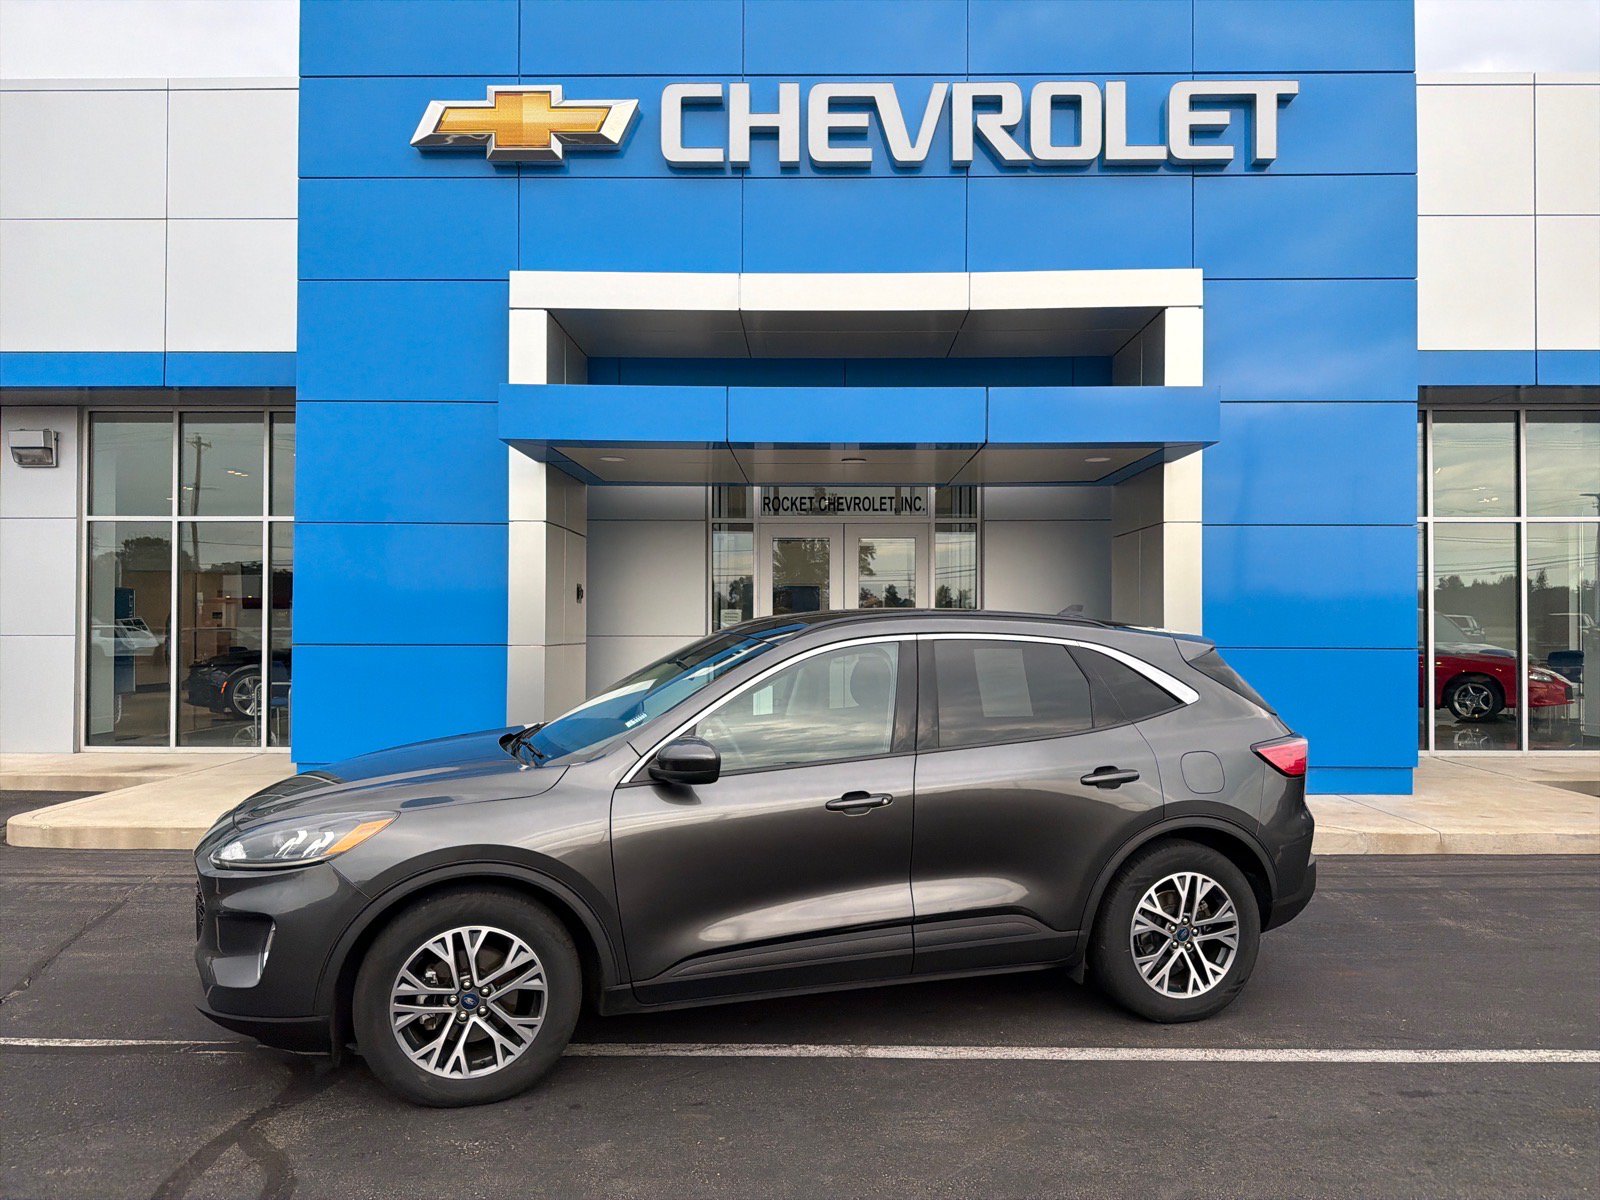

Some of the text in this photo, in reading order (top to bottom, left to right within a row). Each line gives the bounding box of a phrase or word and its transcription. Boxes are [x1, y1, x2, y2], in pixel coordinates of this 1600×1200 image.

[660, 79, 1299, 167] CHEVROLET
[762, 496, 926, 514] ROCKET CHEVROLET, INC.
